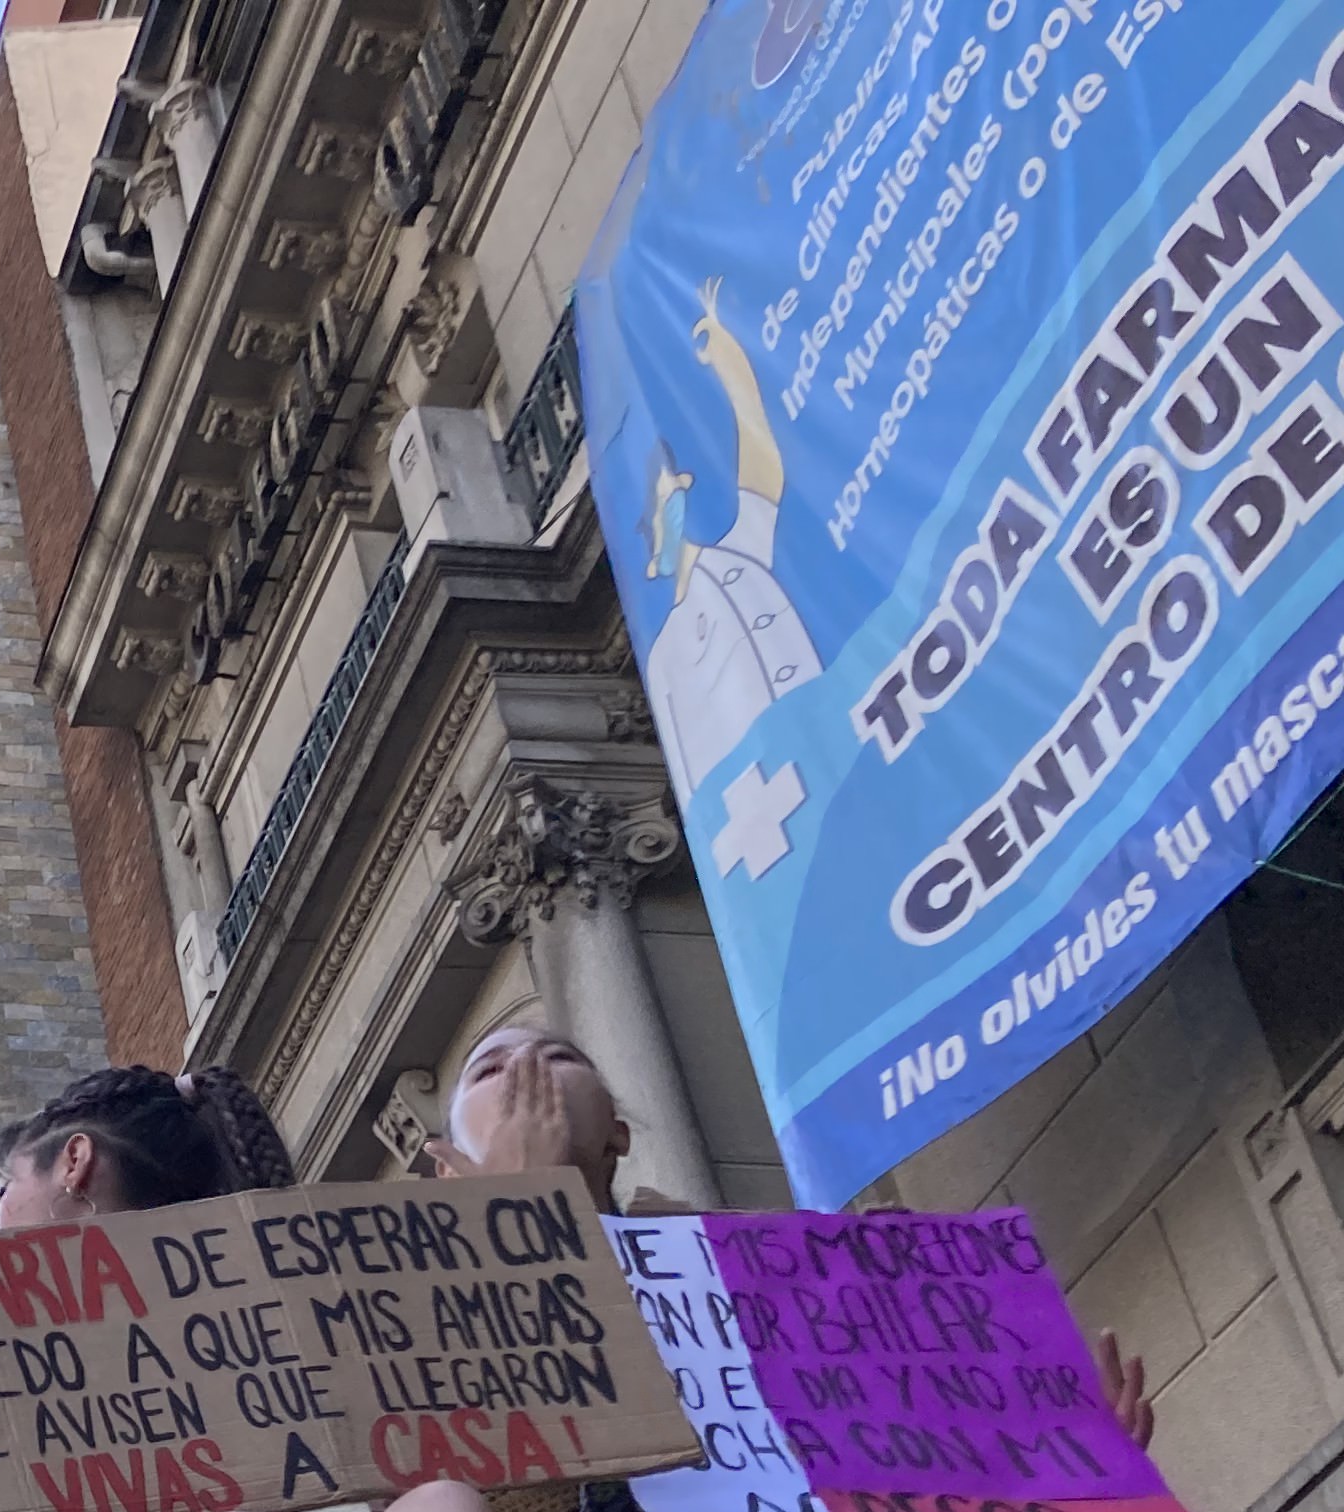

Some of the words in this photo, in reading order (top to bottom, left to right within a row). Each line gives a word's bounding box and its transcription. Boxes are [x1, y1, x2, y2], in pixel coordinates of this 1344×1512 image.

[761, 285, 799, 351] de
[797, 92, 909, 281] Clínicas,
[781, 36, 987, 421] Independientes
[832, 113, 1003, 411] Municipales
[826, 206, 1020, 553] Homeopáticas
[1018, 157, 1047, 199] o
[1050, 73, 1108, 150] de
[1068, 459, 1173, 604] ES
[1162, 277, 1325, 457] UN
[858, 494, 1048, 752] TODA
[902, 569, 1211, 938] CENTRO
[1207, 402, 1344, 576] DE
[981, 871, 1158, 1045] olvides
[1154, 806, 1212, 882] tu
[127, 1322, 178, 1384] A
[183, 1300, 301, 1373] QUE
[315, 1288, 412, 1354] MIS
[433, 1273, 605, 1349] AMIGAS
[153, 1232, 246, 1300] DE
[256, 1203, 479, 1281] ESPERAR
[486, 1190, 588, 1266] CON
[692, 1228, 799, 1279] MIS
[706, 1290, 797, 1352] POR
[790, 1281, 1031, 1355] BAILAR
[36, 1383, 205, 1454] AVISEN
[236, 1363, 344, 1429] QUE
[370, 1347, 618, 1414] LLEGARON
[281, 1432, 339, 1500] A
[792, 1363, 869, 1412] DIA
[878, 1364, 914, 1412] Y
[921, 1364, 1007, 1412] NO
[1014, 1364, 1097, 1412] POR
[849, 1419, 990, 1476] CON
[996, 1425, 1119, 1479] MI
